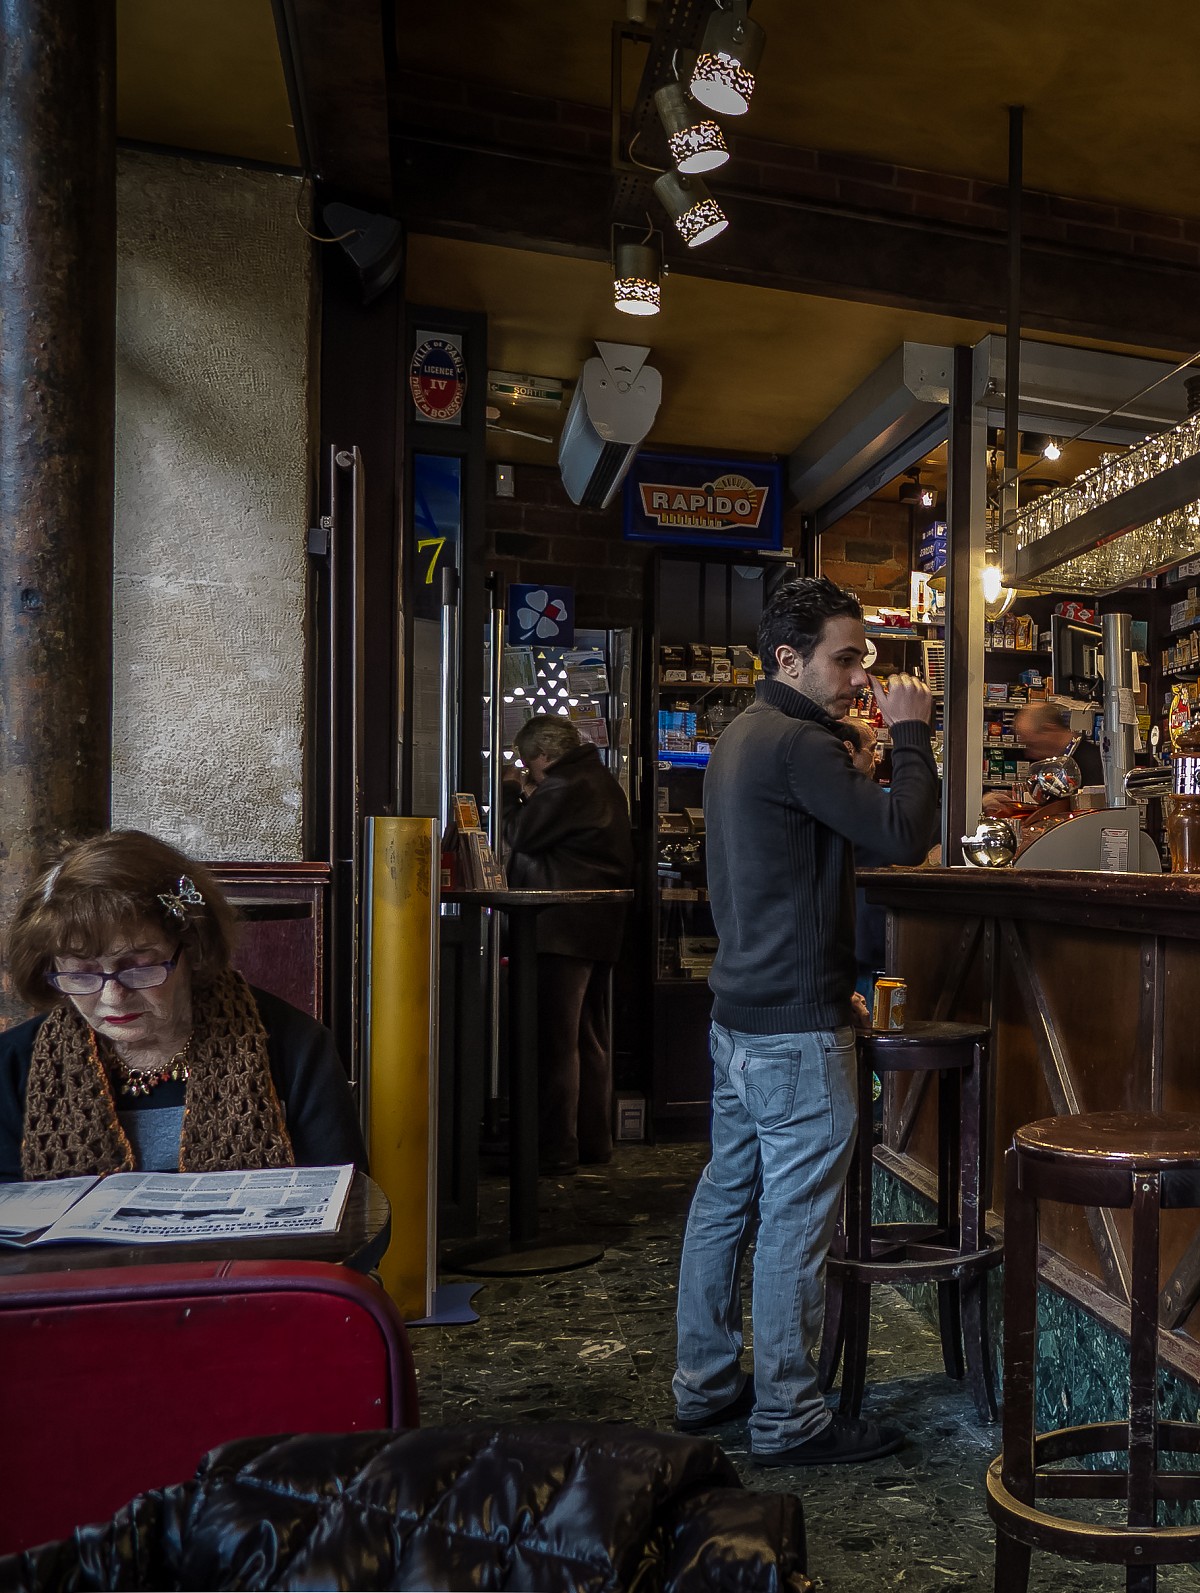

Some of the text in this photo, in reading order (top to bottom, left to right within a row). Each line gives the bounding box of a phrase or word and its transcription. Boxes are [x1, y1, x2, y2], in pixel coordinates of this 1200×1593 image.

[412, 342, 433, 368] VILLE
[445, 343, 465, 374] PARIS
[424, 365, 458, 376] LICENCE
[430, 378, 448, 390] IV
[513, 386, 547, 398] SORTIE
[430, 383, 465, 418] BOISSONS
[652, 490, 753, 516] RAPIDO
[417, 536, 447, 585] 7
